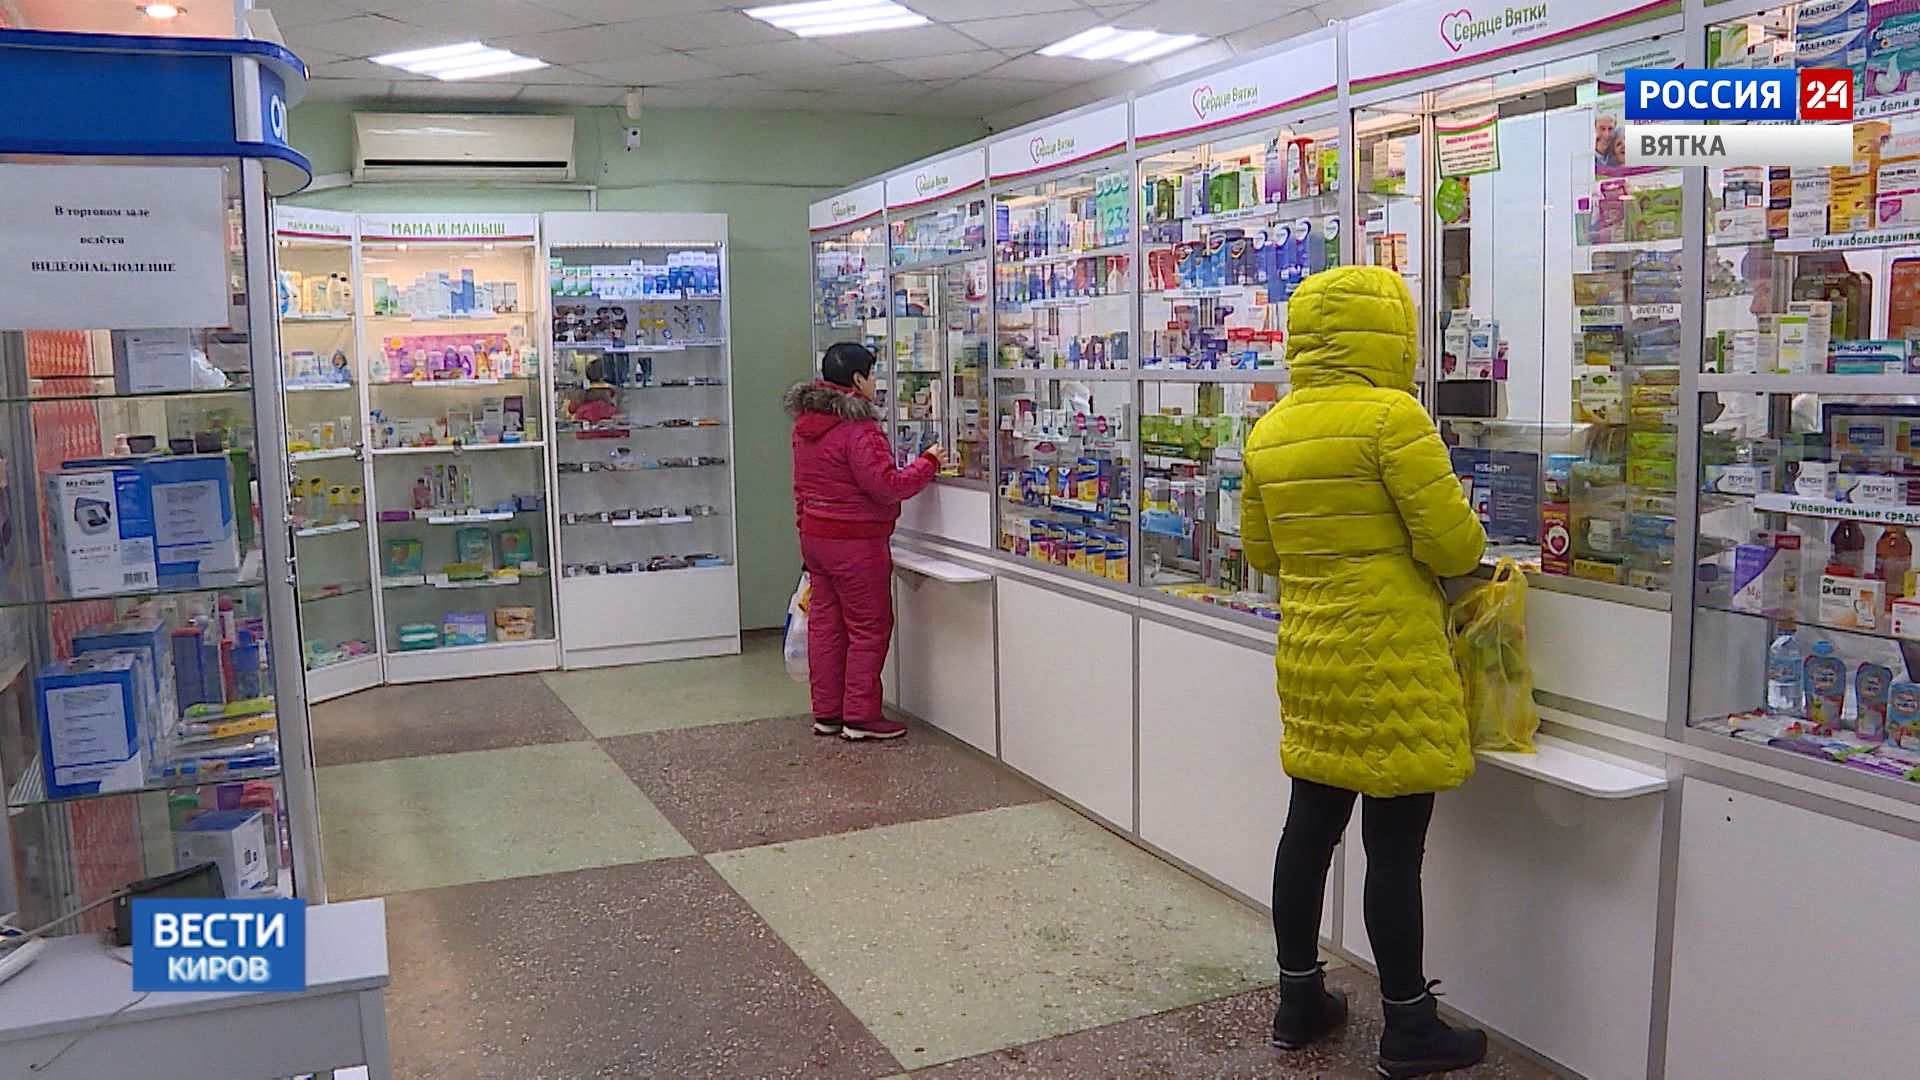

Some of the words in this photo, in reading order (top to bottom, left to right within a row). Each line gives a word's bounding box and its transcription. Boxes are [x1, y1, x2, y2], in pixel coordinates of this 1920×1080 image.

[1454, 15, 1503, 41] Сердце
[1505, 3, 1547, 28] Вятки
[1200, 93, 1231, 112] Сердце
[1232, 85, 1258, 101] Вятки
[1869, 105, 1877, 114] и
[1880, 98, 1909, 113] боли
[54, 205, 64, 216] В
[67, 208, 121, 218] торговом
[126, 208, 150, 217] зале
[391, 222, 433, 235] МАМА
[437, 222, 446, 235] И
[451, 222, 506, 235] МАЛЫШ
[80, 235, 125, 245] ведётся
[1812, 238, 1834, 249] При
[31, 261, 176, 272] ВИДЕОНАБЛЮДЕНИЕ
[1789, 501, 1881, 518] Успокоительные
